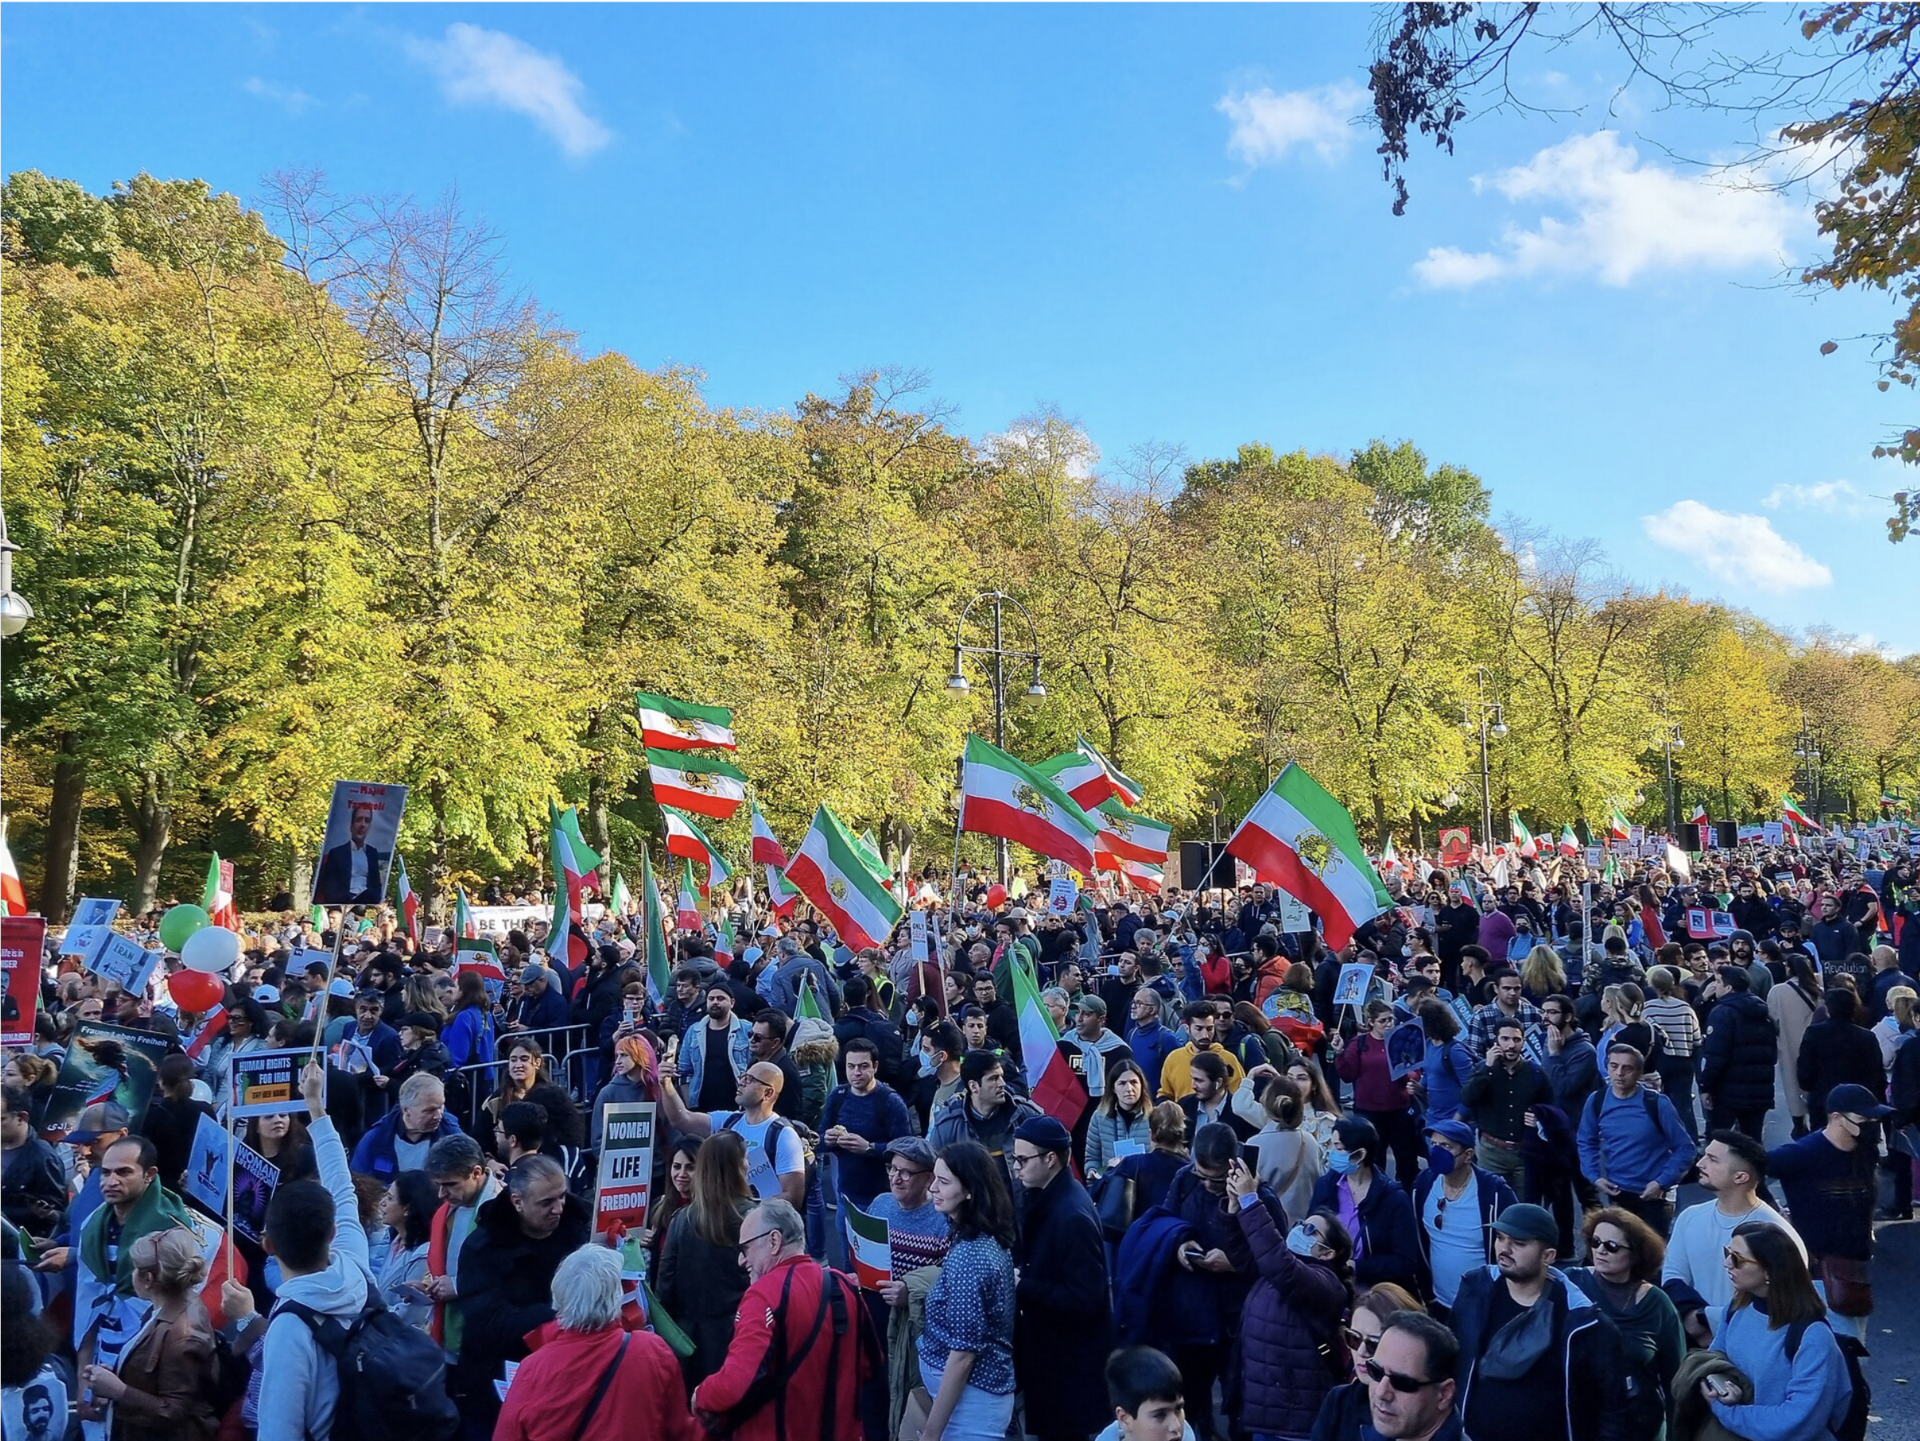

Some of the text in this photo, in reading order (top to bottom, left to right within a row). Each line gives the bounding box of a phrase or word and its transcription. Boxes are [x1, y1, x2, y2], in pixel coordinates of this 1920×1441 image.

[480, 919, 496, 930] BE
[912, 922, 925, 931] ONLY
[113, 942, 135, 961] IRAN
[1824, 961, 1868, 975] Revolution
[1454, 998, 1474, 1026] WOM
[81, 1025, 169, 1048] Frauen Leben Freiheit
[239, 1060, 265, 1072] HUMAN
[266, 1057, 292, 1070] RIGHTS
[259, 1073, 273, 1085] FOR
[274, 1071, 291, 1083] IRAN
[609, 1121, 650, 1140] WOMEN
[237, 1144, 278, 1180] WOMAN
[612, 1156, 641, 1179] LIFE
[600, 1191, 647, 1212] FREEDOM
